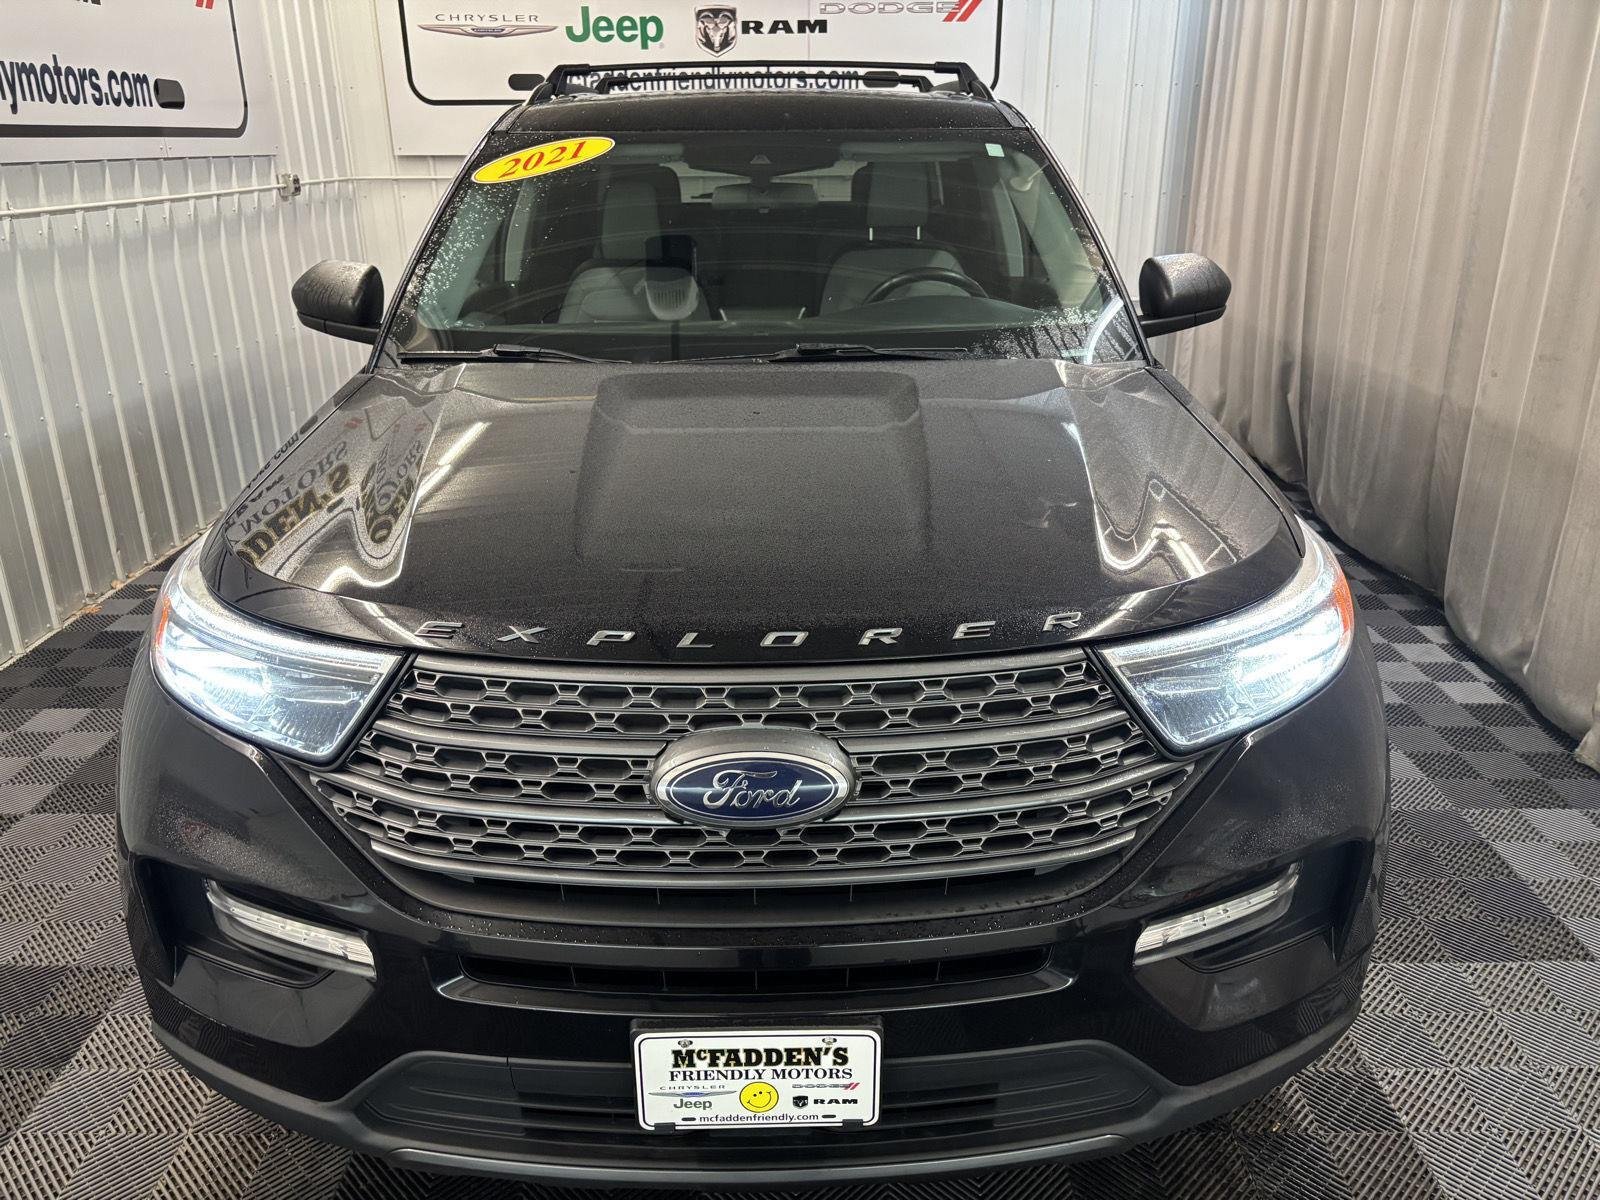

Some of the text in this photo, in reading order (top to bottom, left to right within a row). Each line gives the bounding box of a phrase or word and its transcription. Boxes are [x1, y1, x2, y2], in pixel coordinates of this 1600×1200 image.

[820, 1, 960, 15] DODGE
[435, 13, 539, 23] CHRYSLER
[565, 6, 664, 49] Jeep
[741, 19, 828, 34] RAM
[498, 141, 587, 178] 2021
[414, 611, 1082, 648] EXPLORER
[703, 769, 803, 809] Ford
[669, 1067, 853, 1082] FRIENDLY MOTORS
[673, 1098, 713, 1111] Jeep
[699, 1112, 819, 1123] mcfaddenfriendly.com
